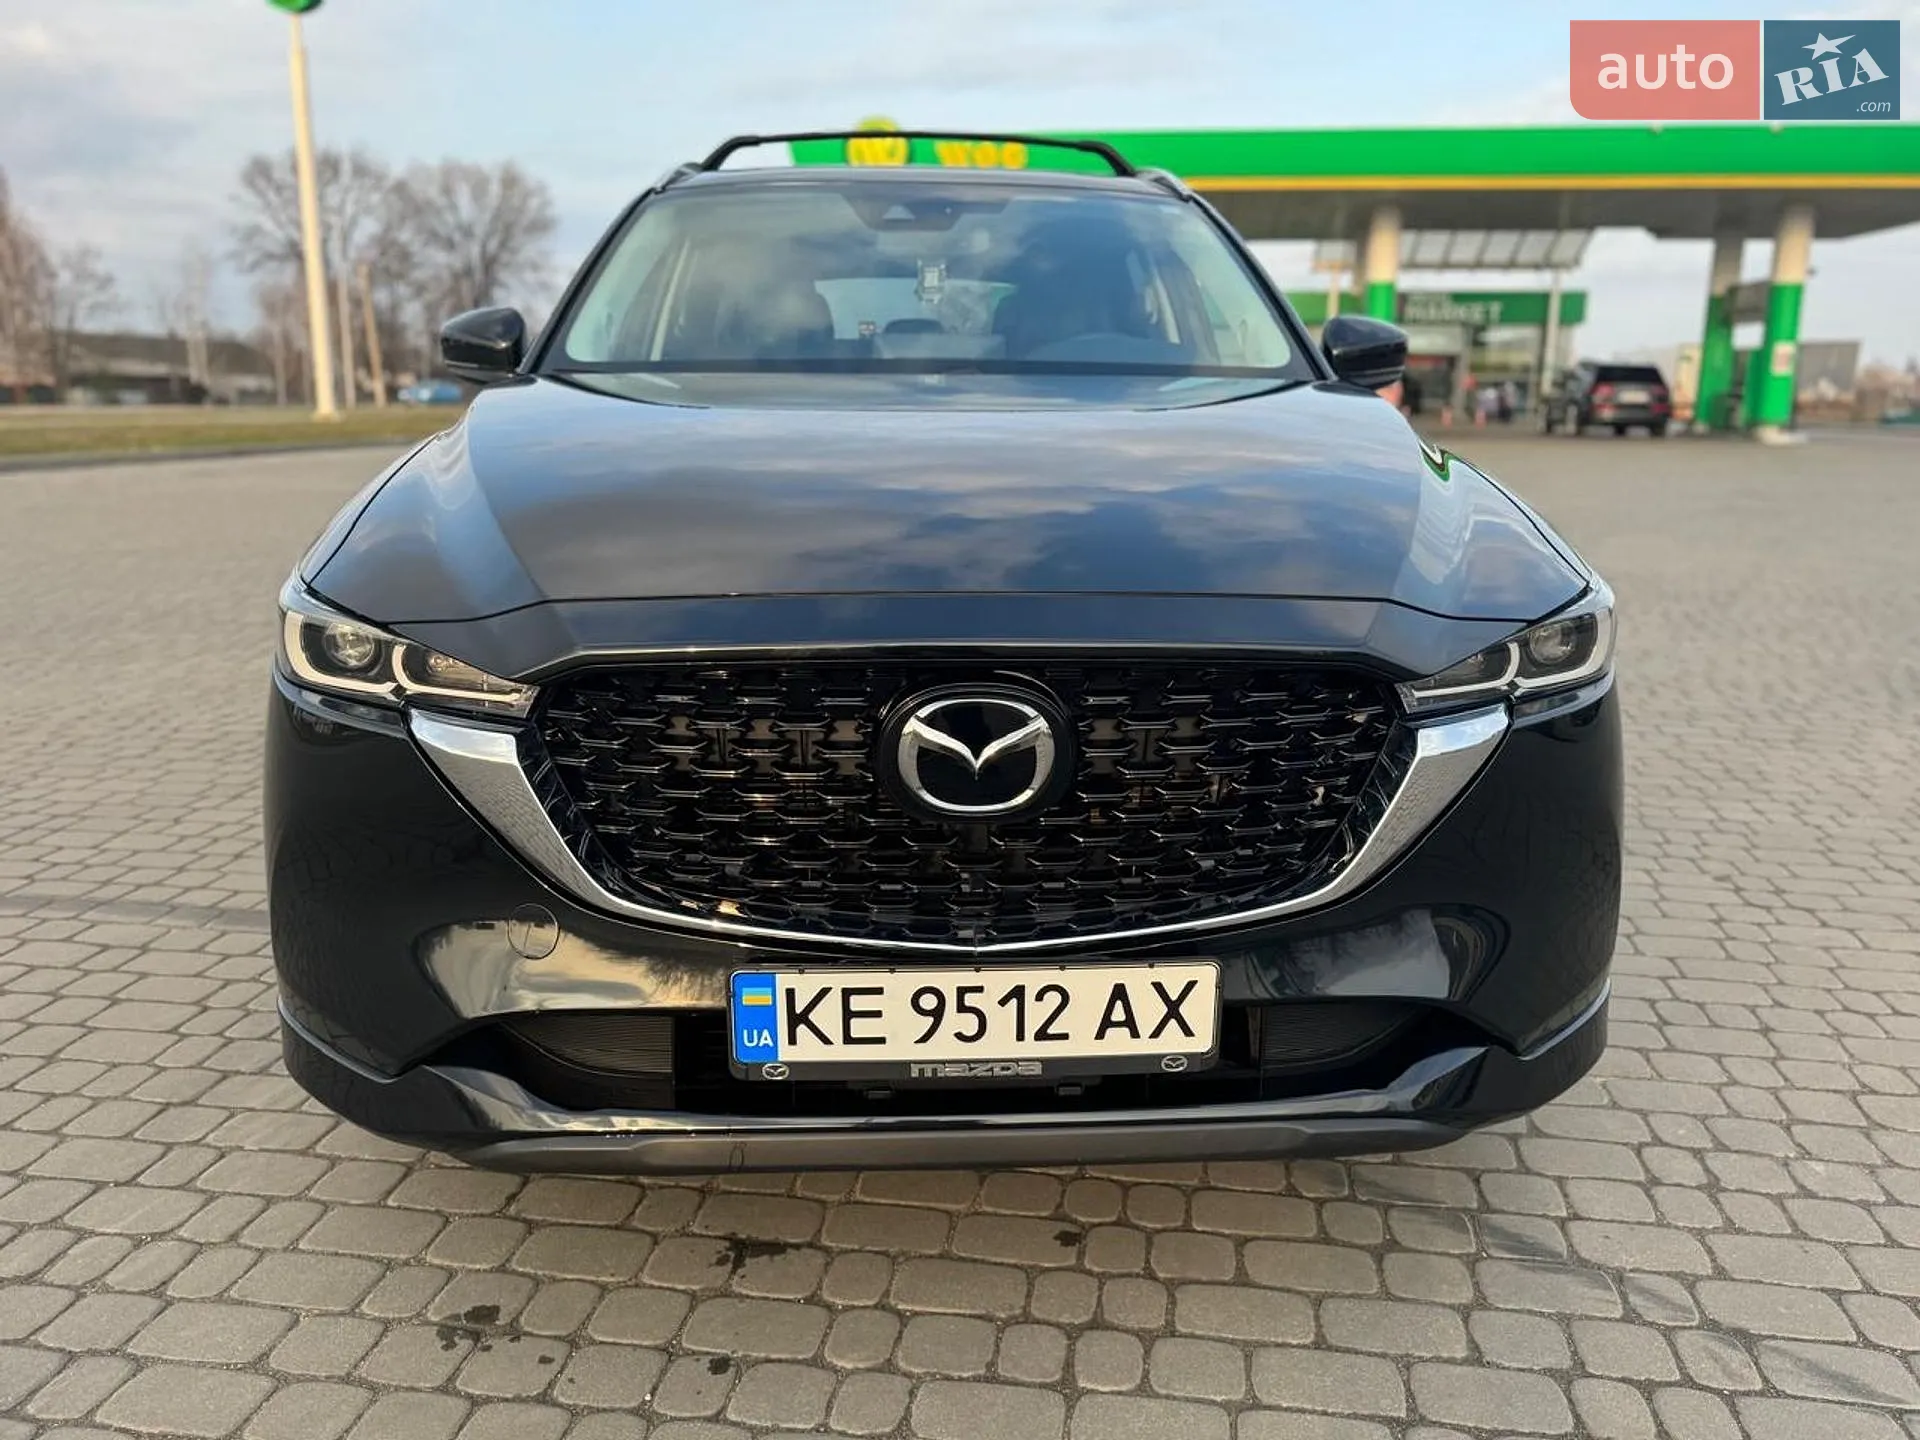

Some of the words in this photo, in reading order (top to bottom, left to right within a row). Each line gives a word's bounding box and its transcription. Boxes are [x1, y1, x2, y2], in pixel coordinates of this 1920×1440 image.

[785, 986, 887, 1046] KE
[910, 984, 1070, 1044] 9512
[1094, 979, 1199, 1041] AX
[743, 1029, 774, 1049] UA
